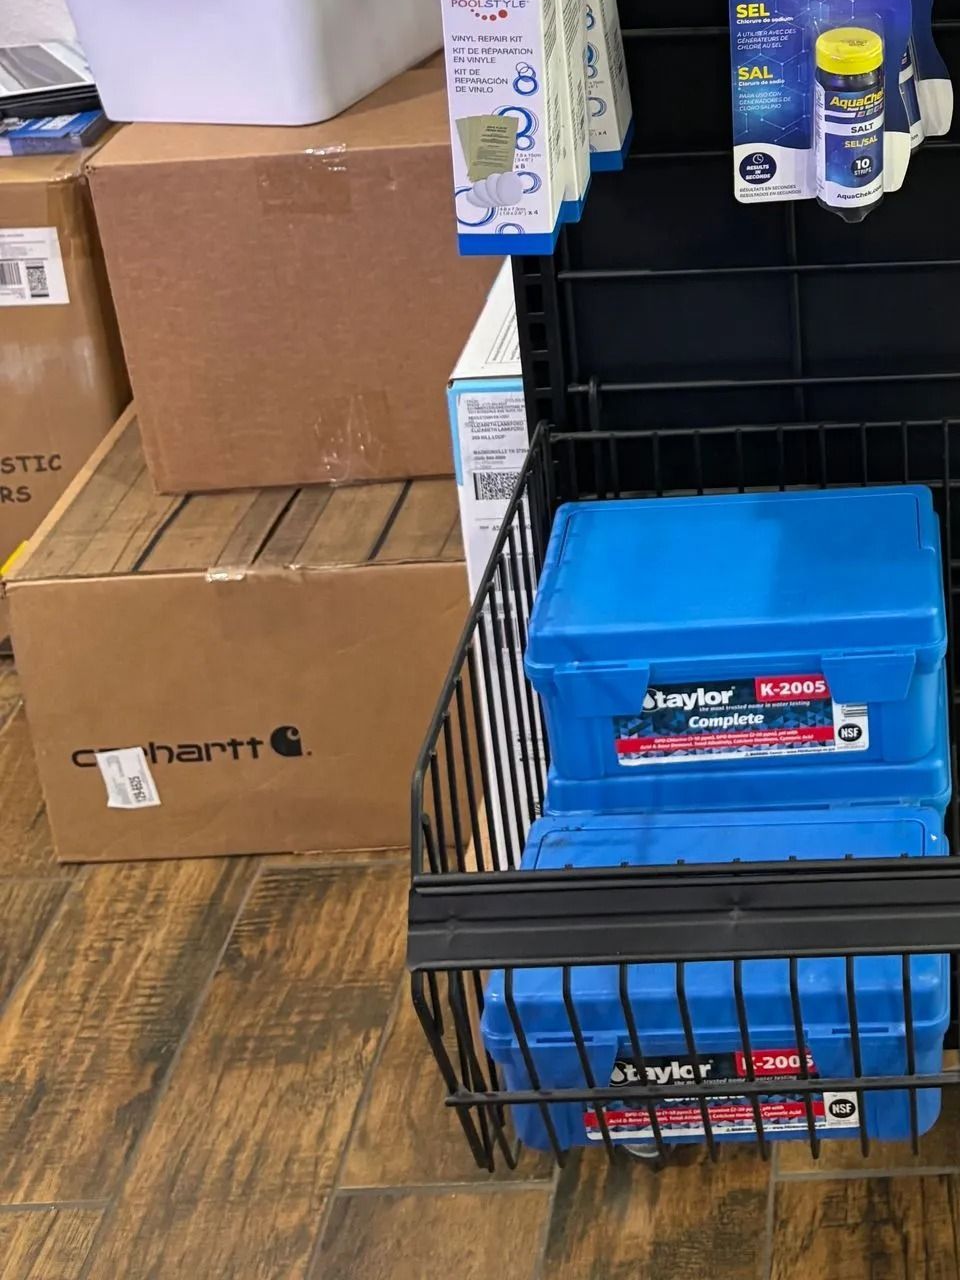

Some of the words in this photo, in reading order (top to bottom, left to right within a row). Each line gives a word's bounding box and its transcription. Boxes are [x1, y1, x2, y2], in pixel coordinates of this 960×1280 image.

[451, 0, 526, 8] POOLSTYLE
[736, 3, 770, 18] SEL
[477, 35, 508, 43] REPAIR
[481, 46, 533, 55] RÉPARATION
[738, 66, 774, 80] SAL
[454, 76, 508, 85] REPARACIÓN
[455, 85, 466, 93] DE
[851, 122, 874, 133] SALT
[844, 135, 878, 148] SEL/SAL
[855, 158, 870, 169] 10
[760, 680, 827, 696] K-2005
[655, 688, 734, 711] taylor
[689, 712, 765, 729] Complete
[840, 727, 859, 738] NSF
[71, 737, 264, 768] chartt
[831, 1102, 852, 1114] NSF
